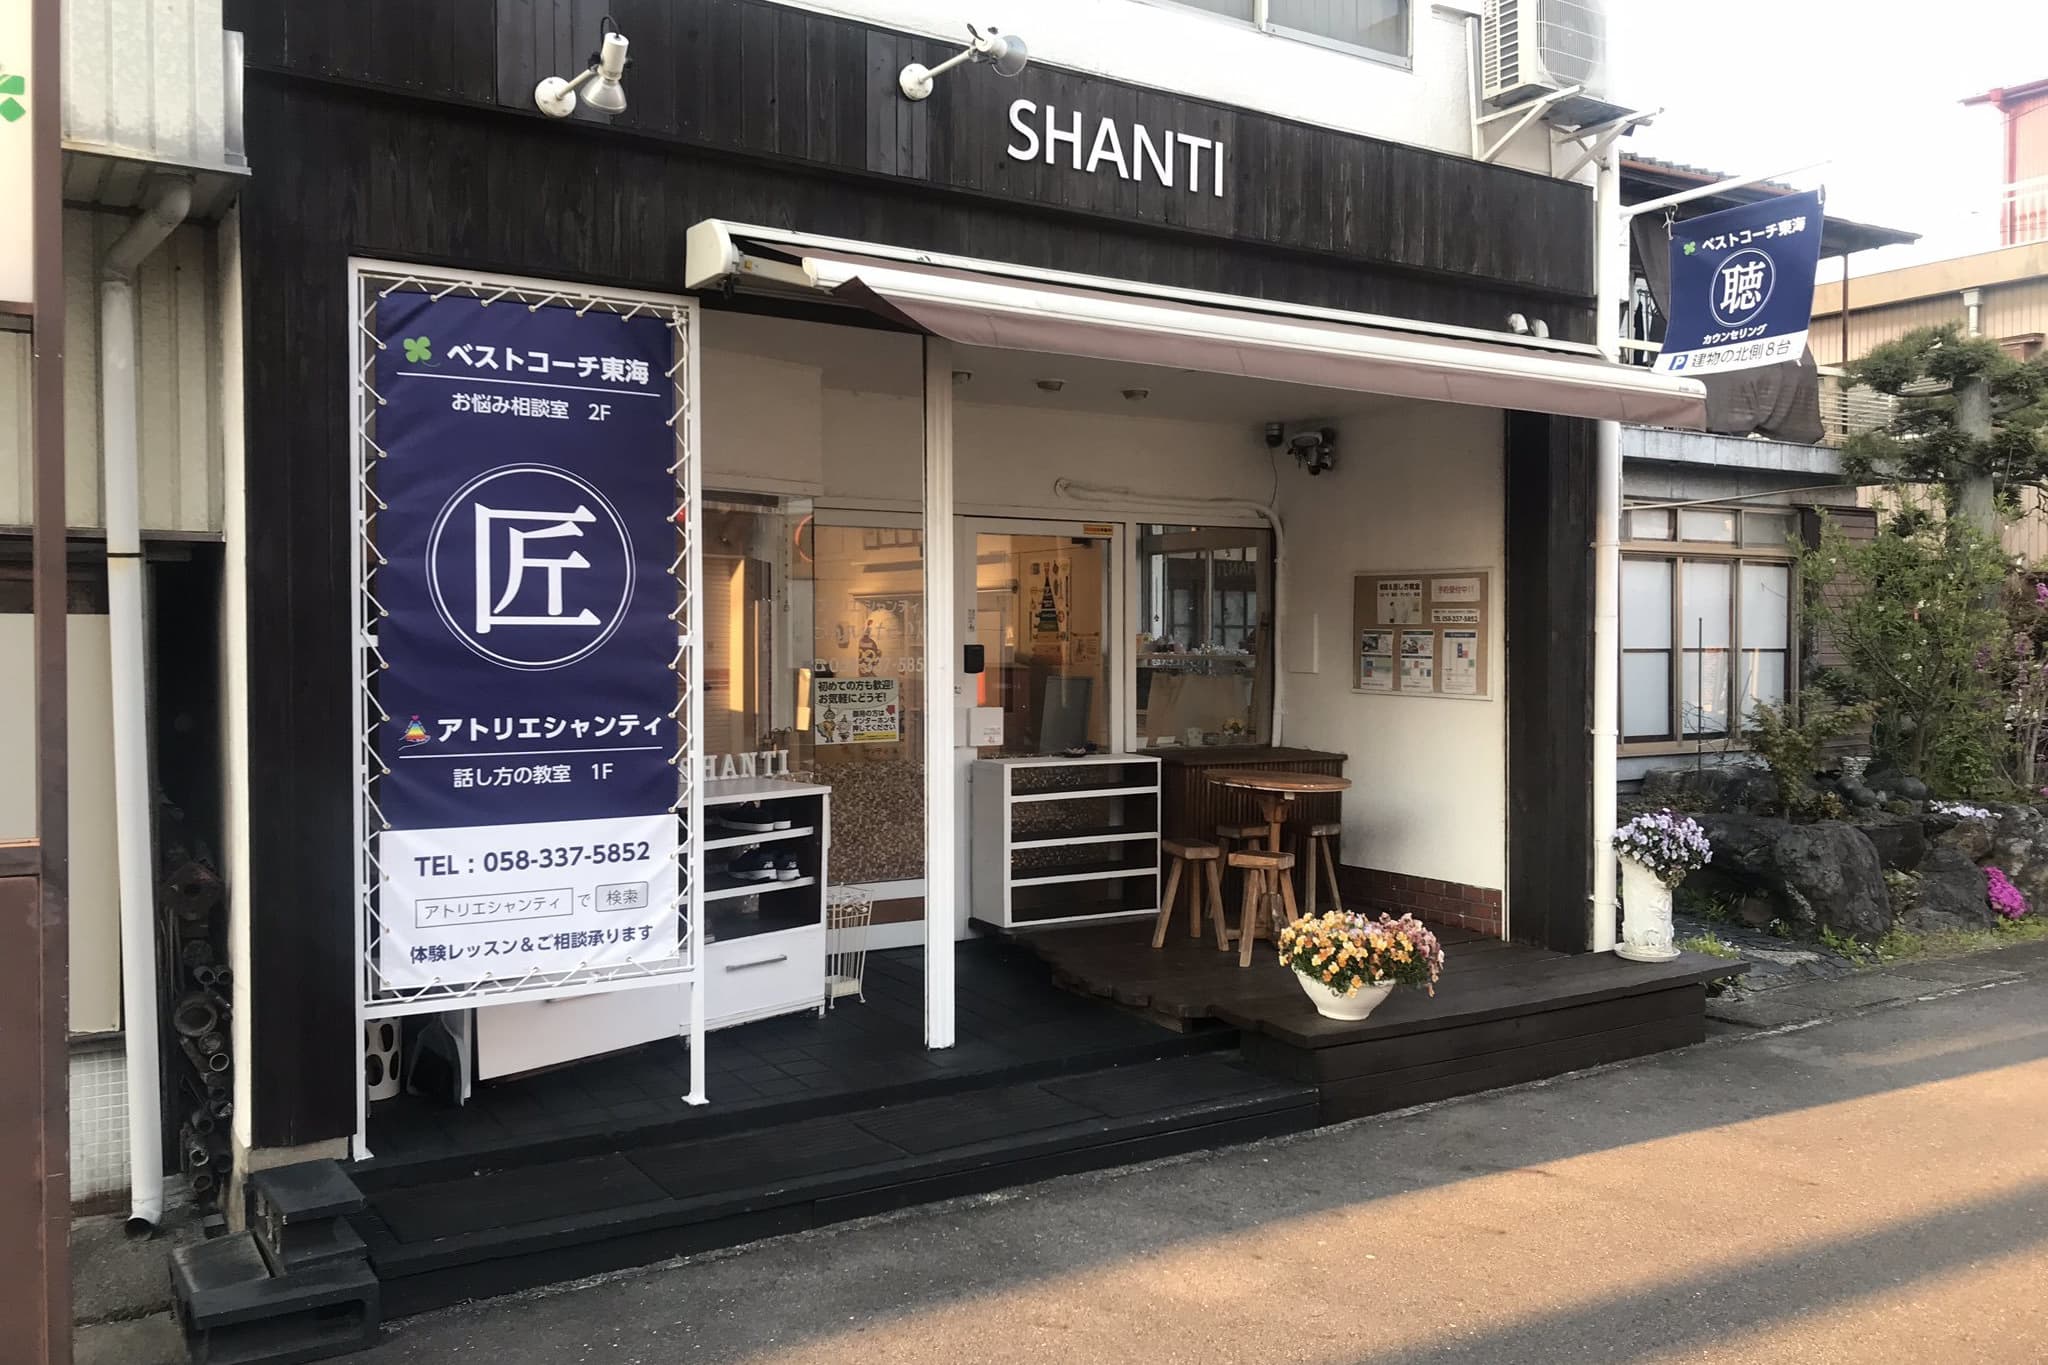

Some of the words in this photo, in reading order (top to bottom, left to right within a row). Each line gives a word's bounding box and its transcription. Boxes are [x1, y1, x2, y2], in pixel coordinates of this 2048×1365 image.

[1007, 99, 1224, 198] SHANTI
[1702, 216, 1806, 251] ベストコーチ東海
[1720, 261, 1766, 314] 聴
[1702, 324, 1768, 345] カウンセリング
[447, 344, 649, 384] ベストコーチ東海
[451, 392, 569, 420] お悩み相談室
[588, 404, 611, 421] 2F
[475, 502, 602, 633] 匠
[437, 714, 662, 743] アトリエシャンティ
[453, 764, 572, 788] 話し方の教室
[591, 763, 614, 781] 1F
[424, 896, 562, 920] アトリエシャンティ
[605, 889, 639, 907] 検索
[410, 924, 654, 965] 体験レッスン＆ご相談承ります
